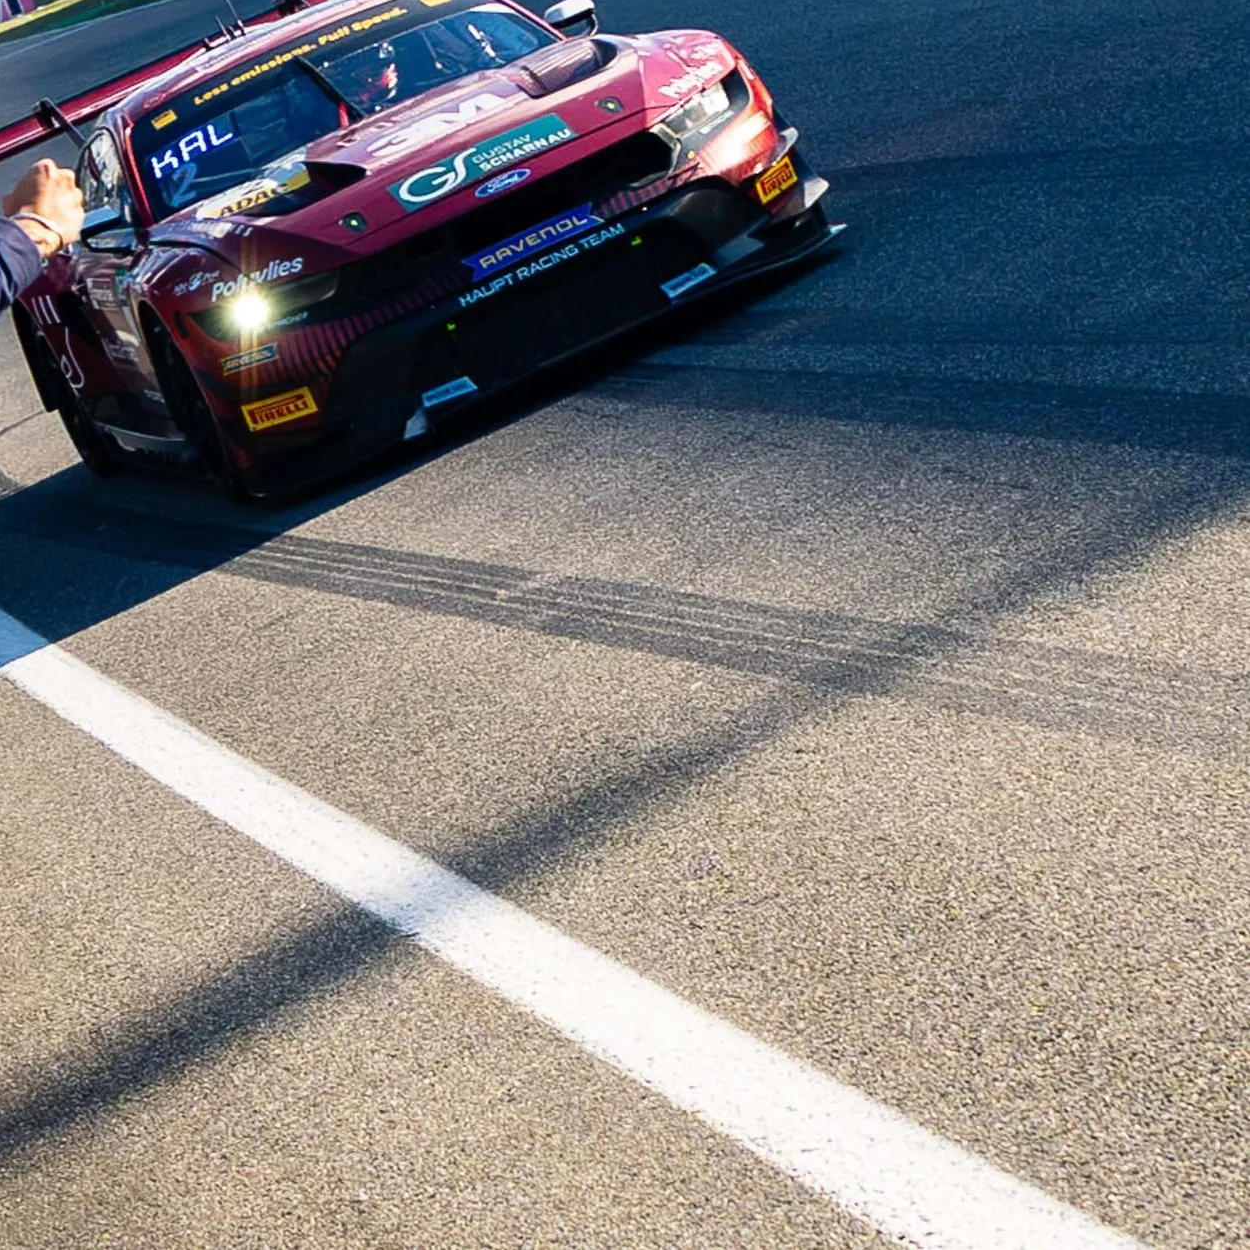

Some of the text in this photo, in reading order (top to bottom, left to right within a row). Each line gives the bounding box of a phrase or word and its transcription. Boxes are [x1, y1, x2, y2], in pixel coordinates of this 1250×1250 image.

[150, 124, 234, 179] KAL
[471, 133, 533, 165] GUSTAV
[478, 127, 572, 173] SCHARNAU
[458, 222, 626, 307] HAUPT RACING TEAM
[479, 214, 589, 270] RAVENOL
